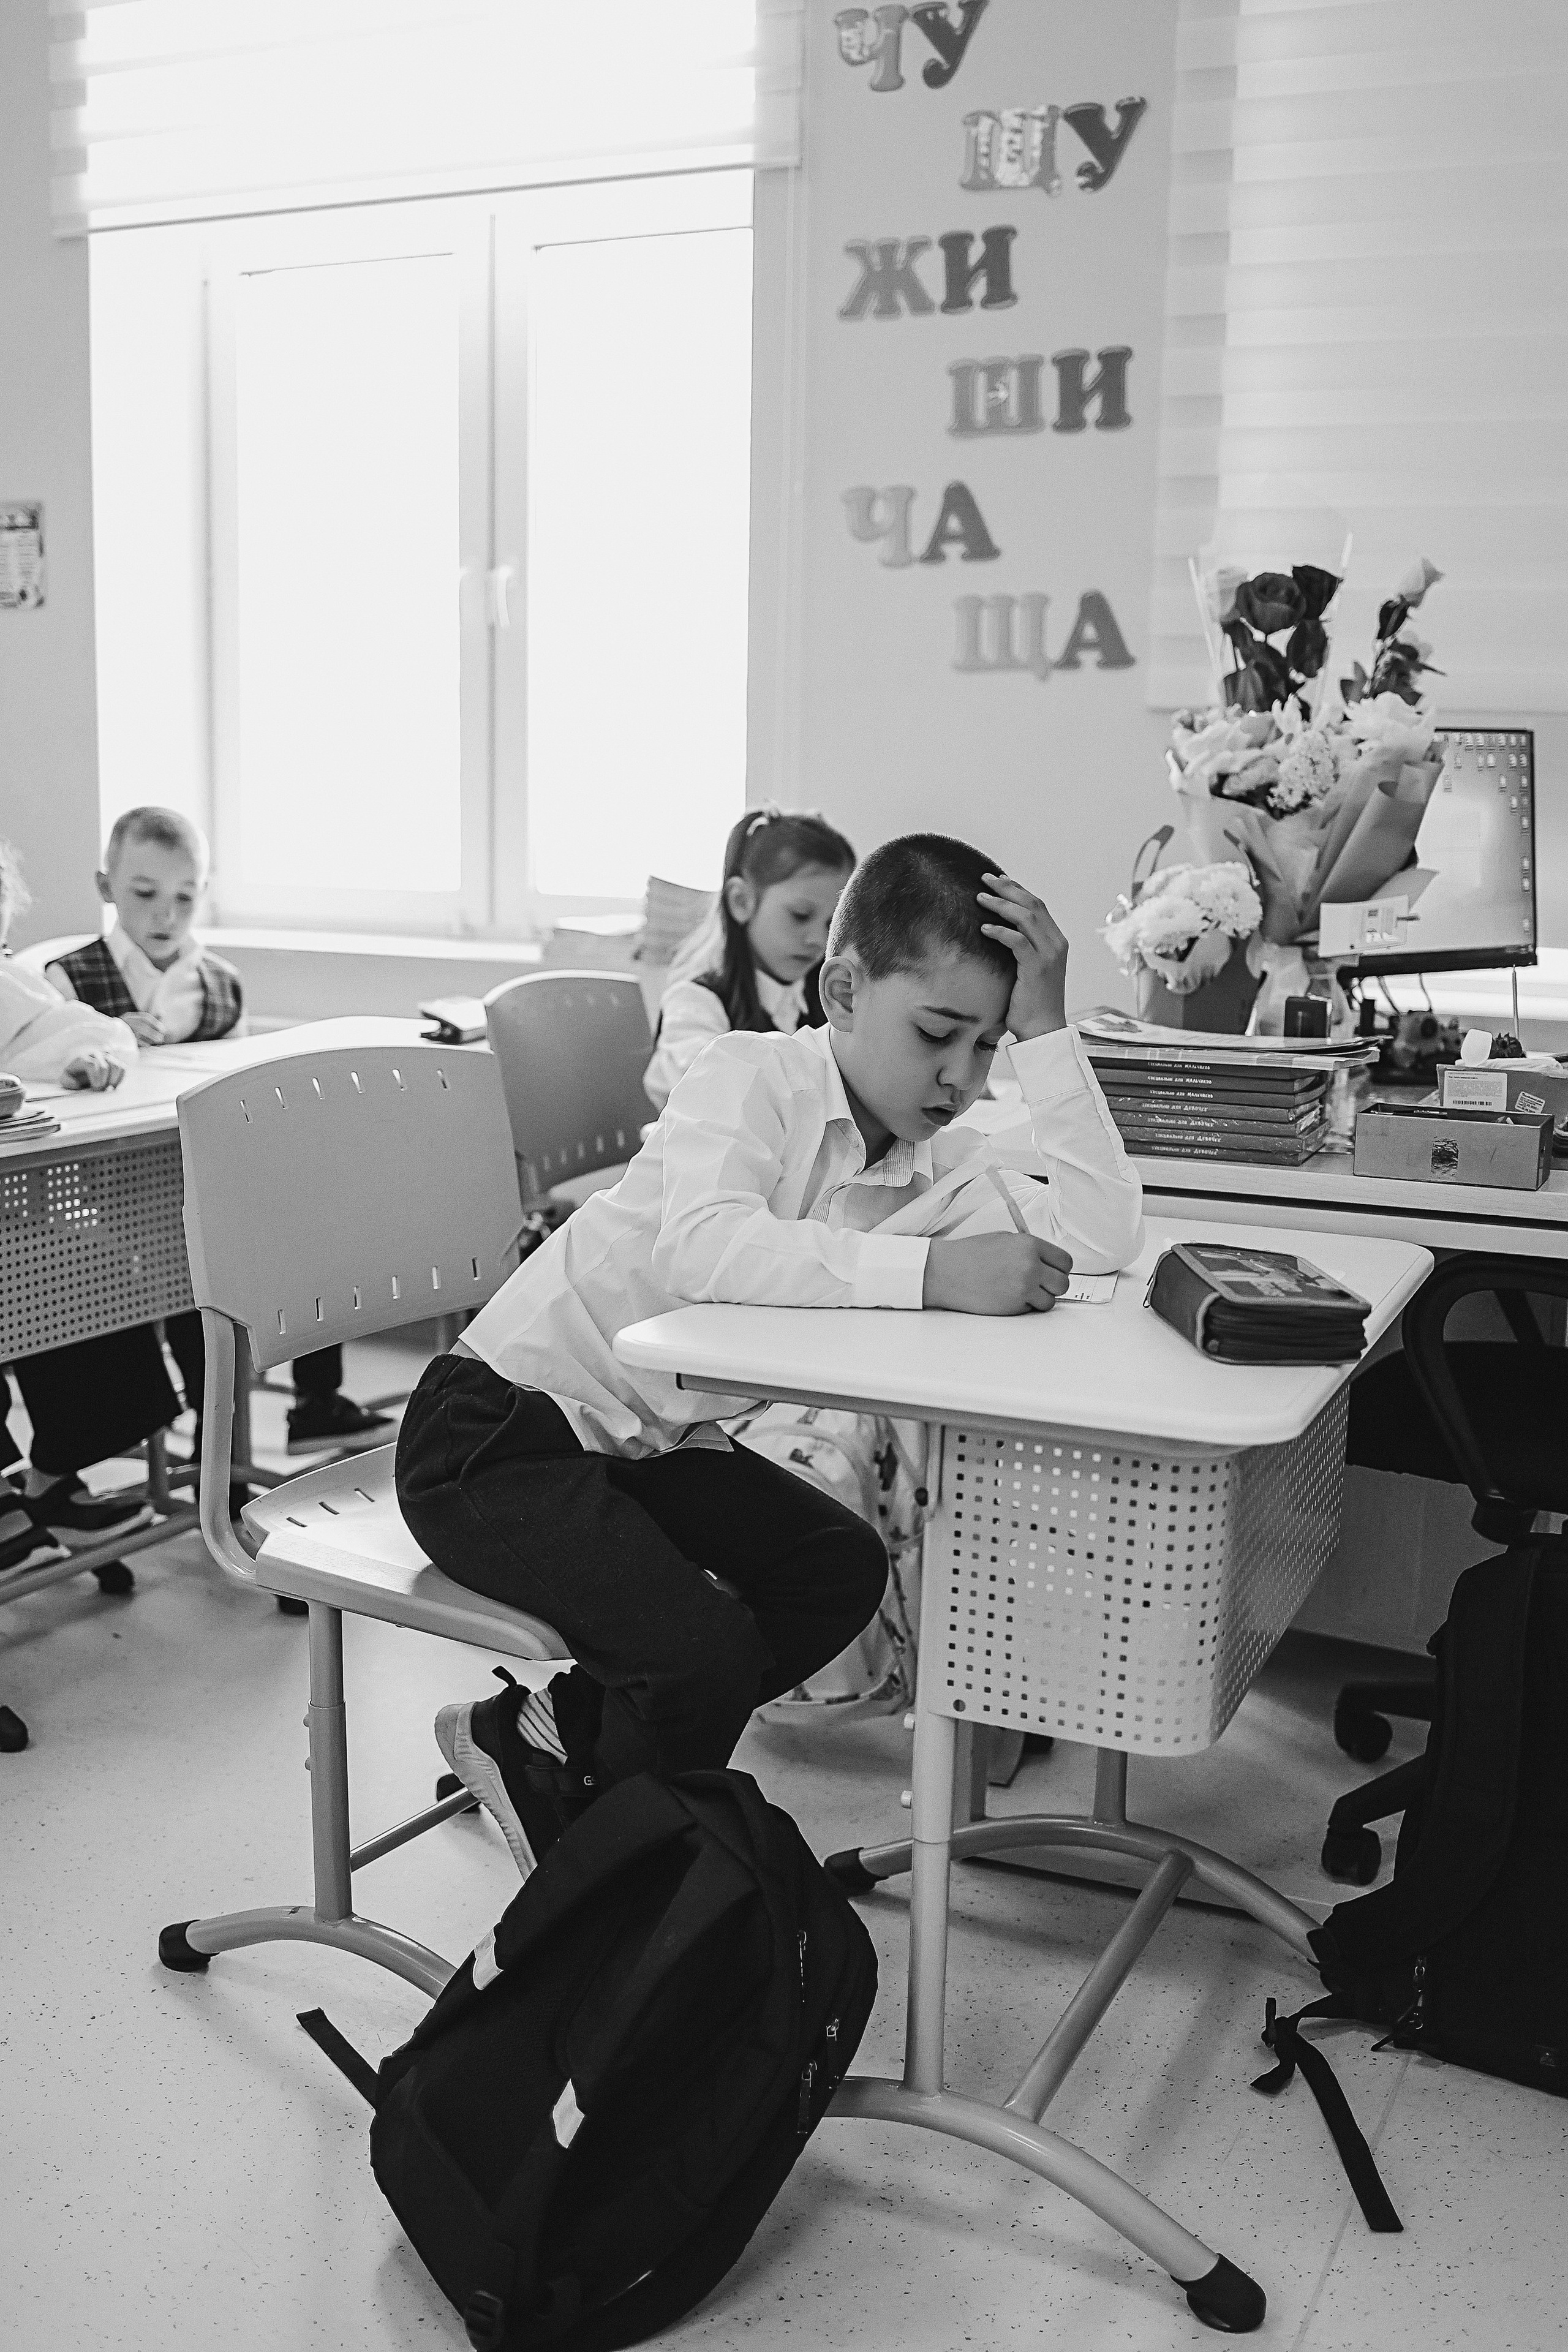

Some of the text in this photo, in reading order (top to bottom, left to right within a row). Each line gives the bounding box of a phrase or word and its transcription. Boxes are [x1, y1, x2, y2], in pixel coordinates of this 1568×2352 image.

[834, 0, 989, 91] ЧУ
[837, 225, 1017, 322] ЖИ
[946, 345, 1134, 440] ШИ
[842, 481, 1001, 570] ЧА
[952, 589, 1137, 682] ЩА
